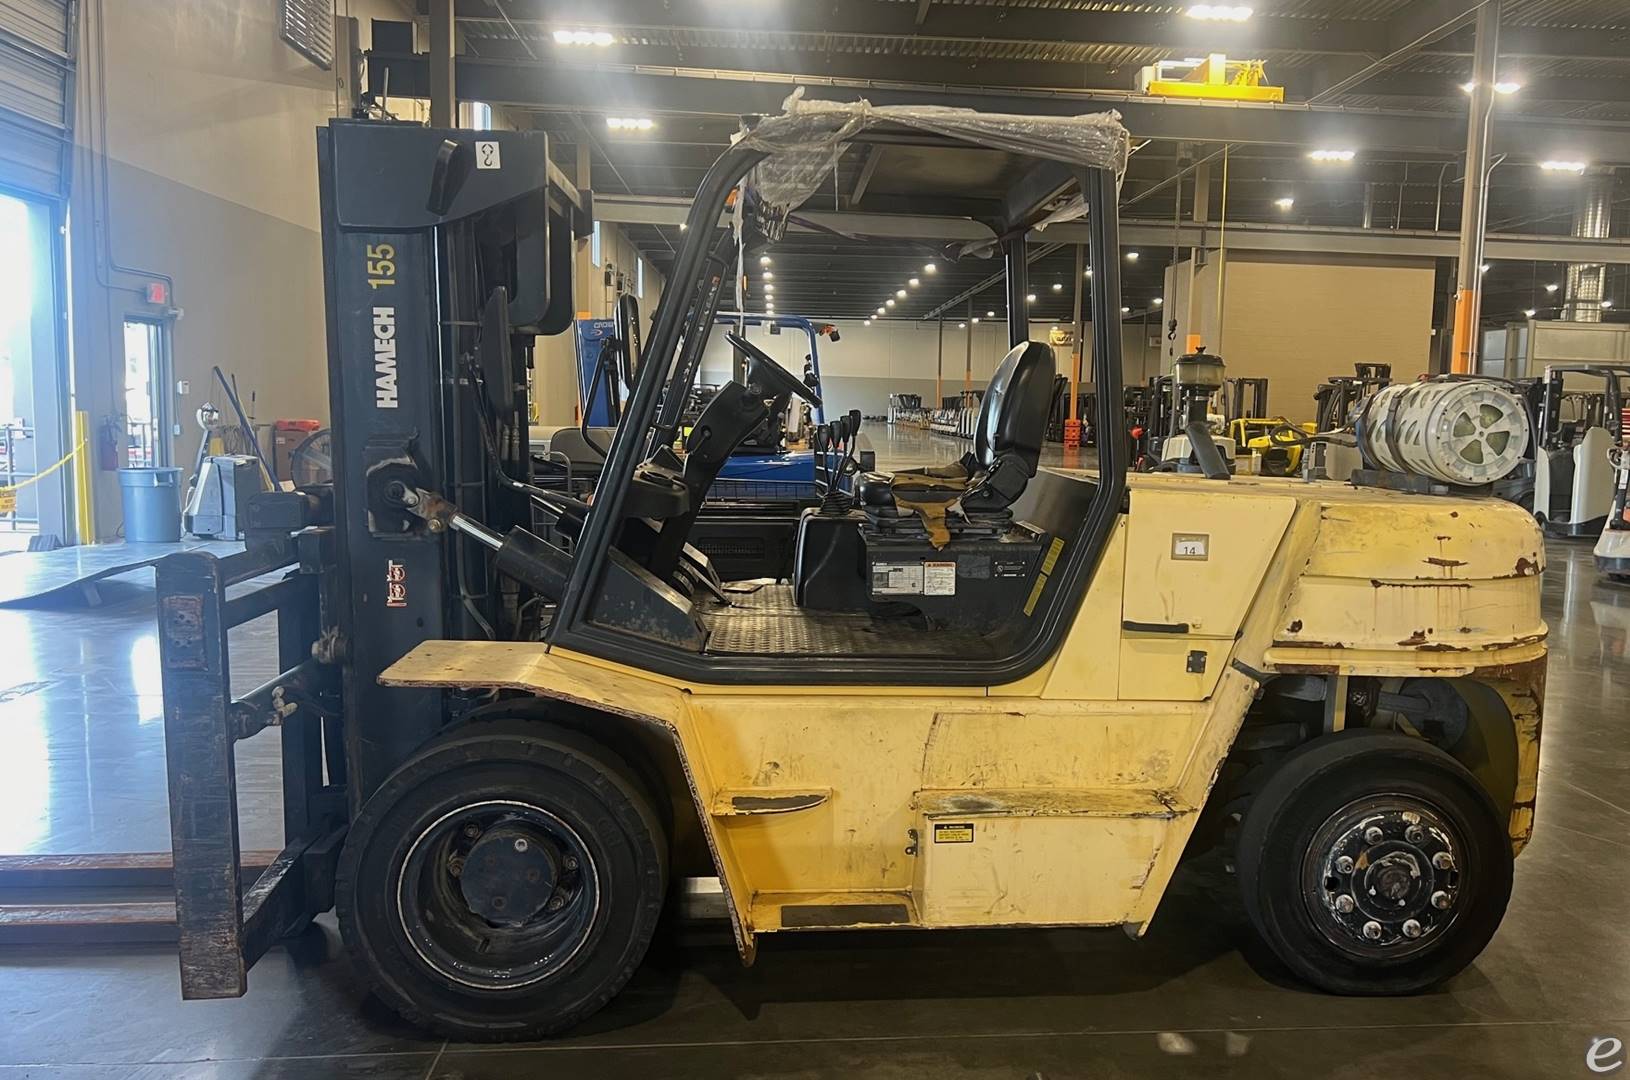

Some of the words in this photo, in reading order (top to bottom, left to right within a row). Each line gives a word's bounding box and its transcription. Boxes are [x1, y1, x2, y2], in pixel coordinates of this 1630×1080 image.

[366, 243, 396, 290] 155
[593, 321, 614, 329] CROW
[372, 306, 398, 409] HAMECH
[1183, 546, 1196, 556] 14
